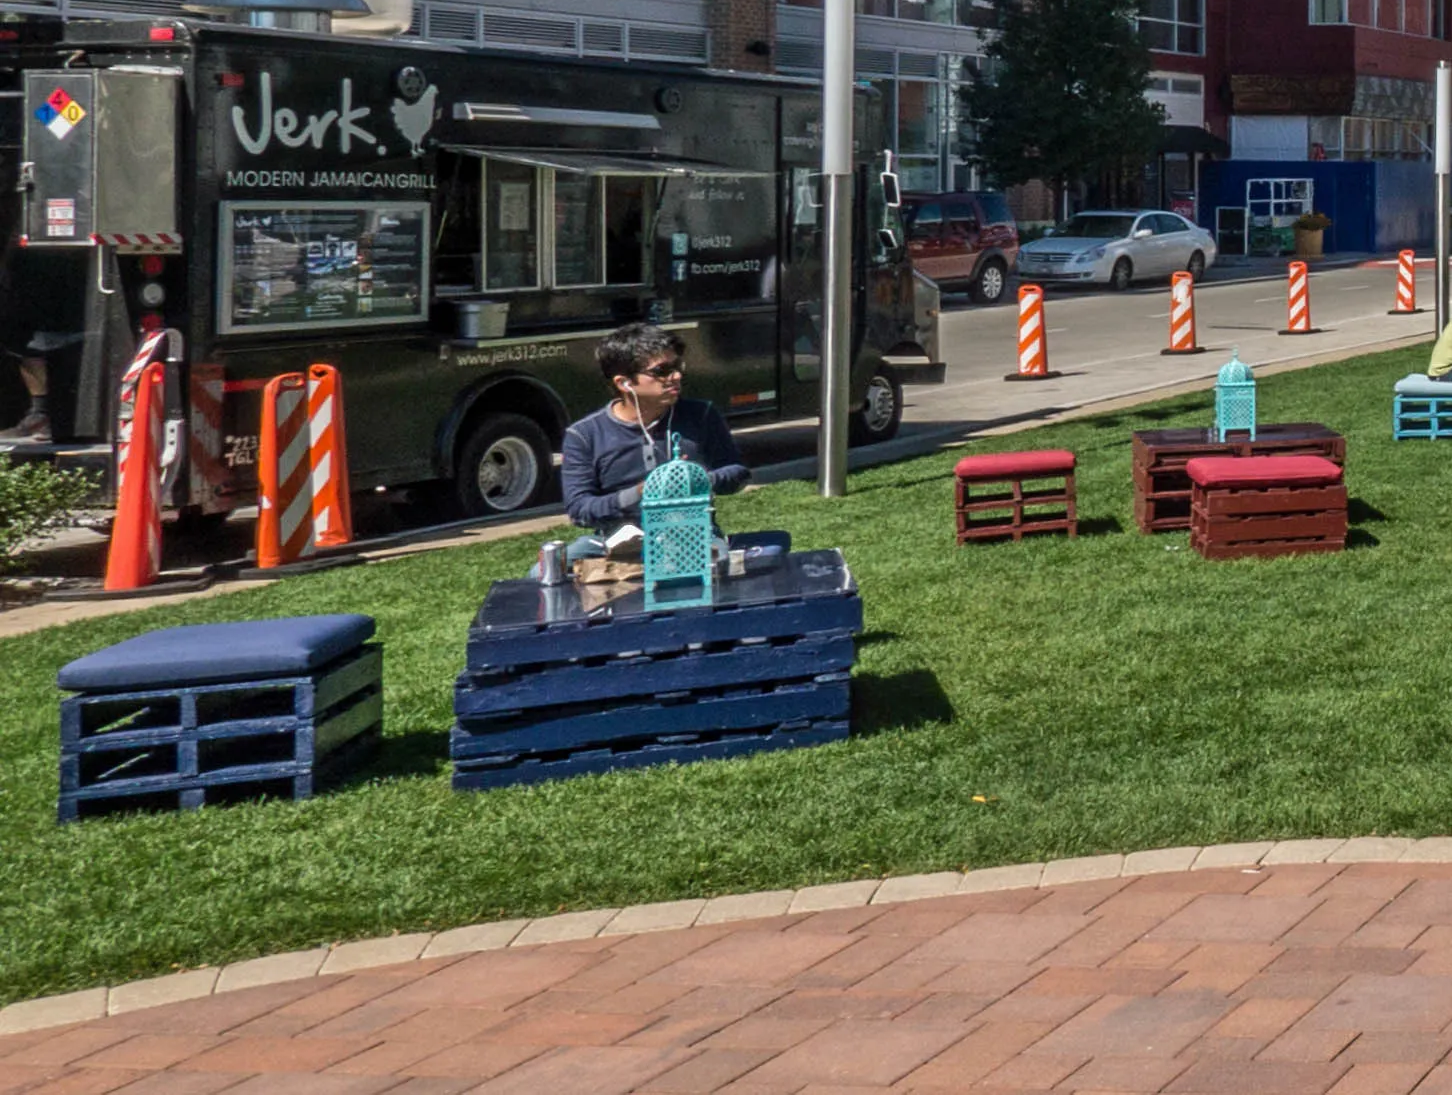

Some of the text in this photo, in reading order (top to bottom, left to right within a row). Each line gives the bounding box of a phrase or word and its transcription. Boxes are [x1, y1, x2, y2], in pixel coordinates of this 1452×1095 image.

[226, 171, 306, 187] MODERN
[691, 259, 761, 275] fb.com/jerk312
[457, 344, 568, 366] www.jerk312.com
